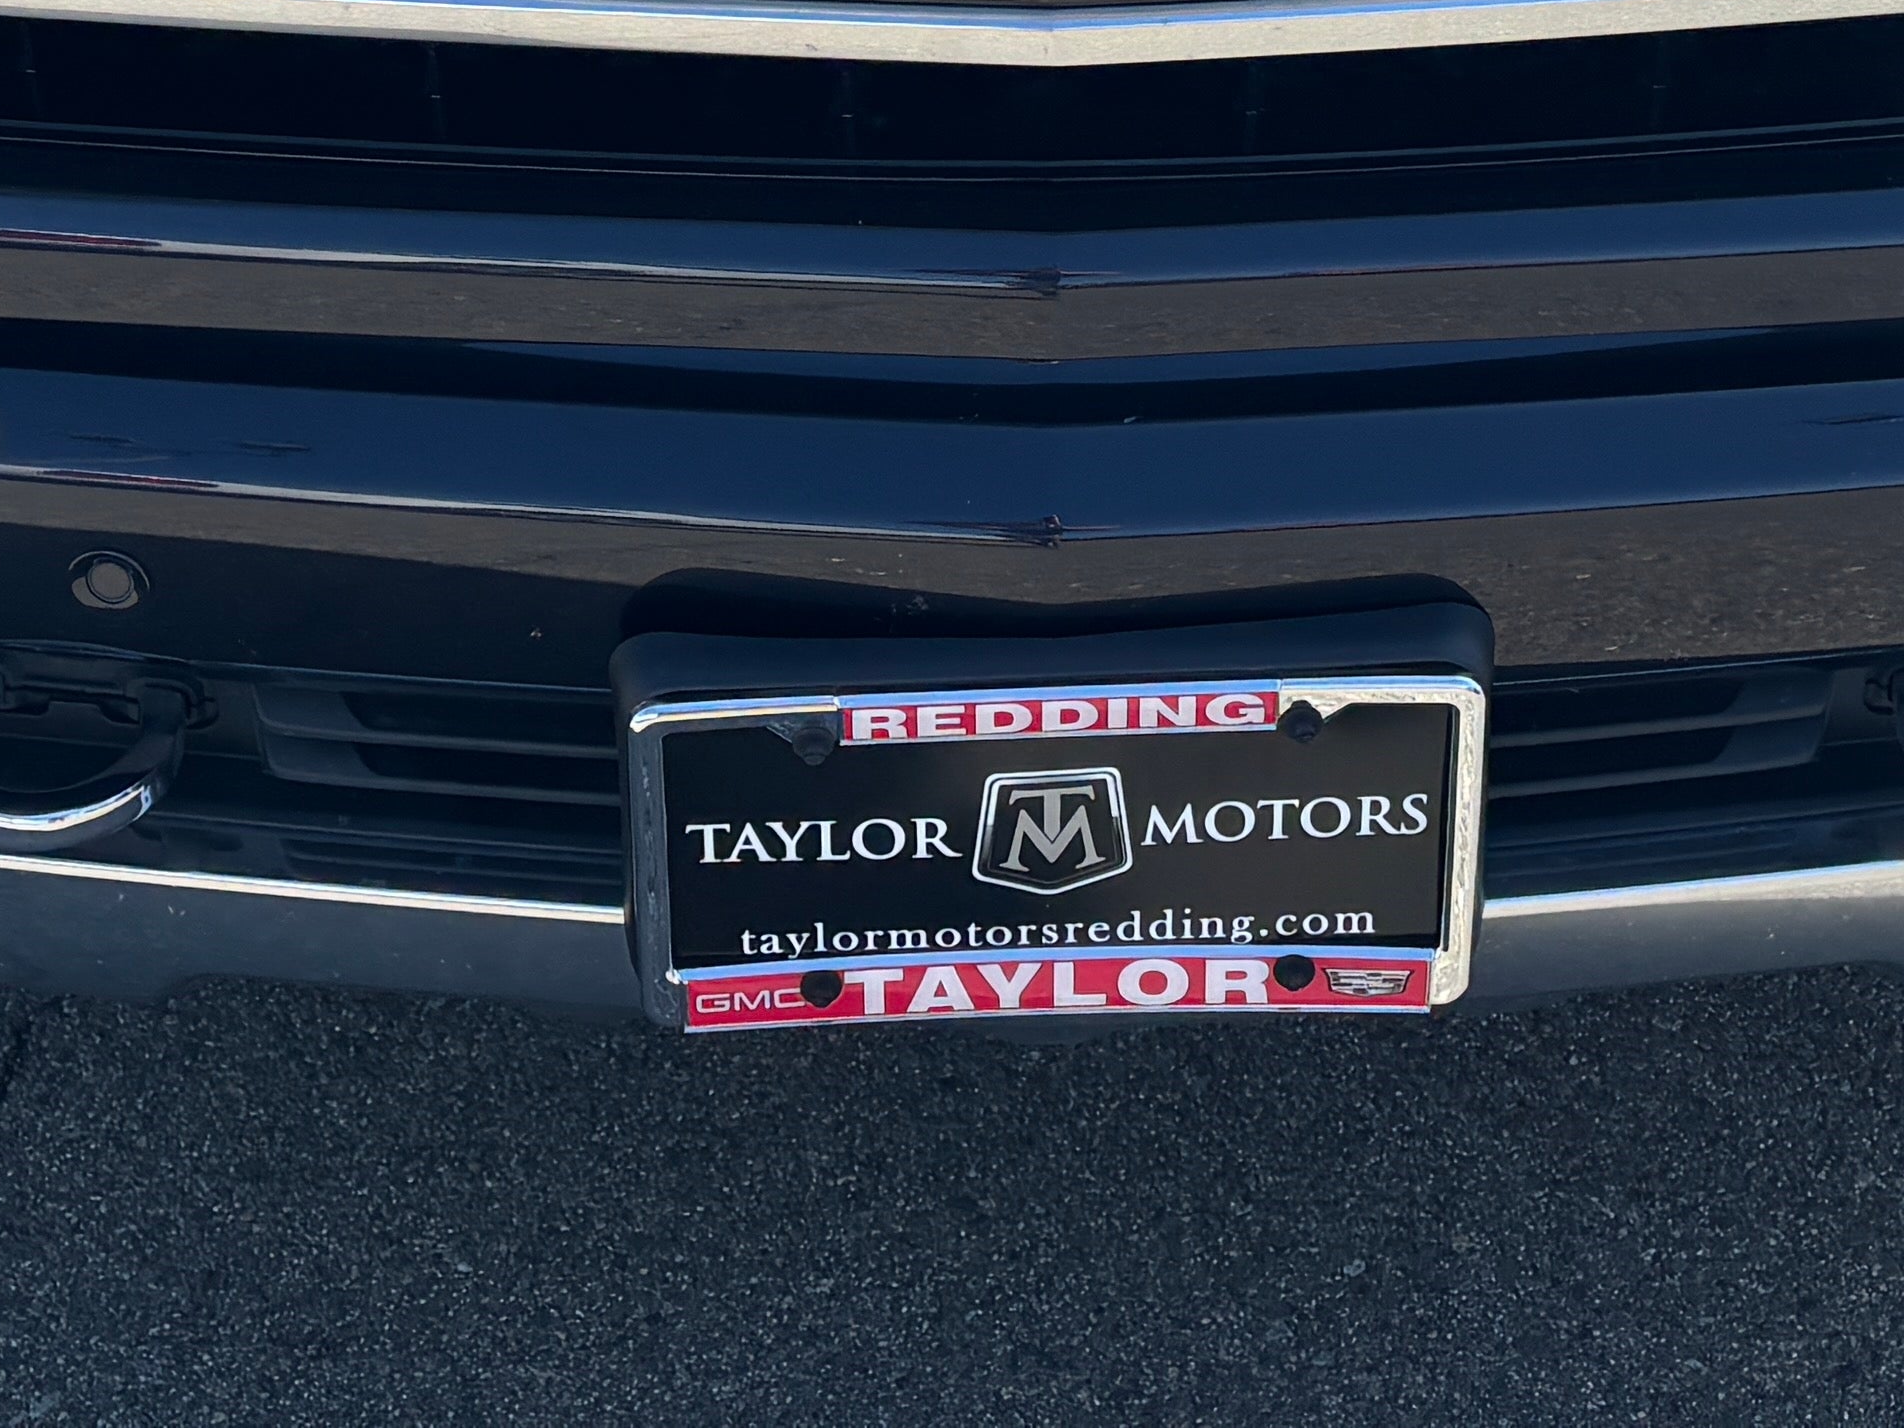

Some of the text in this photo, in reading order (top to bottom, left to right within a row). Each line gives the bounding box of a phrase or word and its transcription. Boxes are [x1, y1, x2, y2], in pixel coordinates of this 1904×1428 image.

[851, 693, 1267, 740] REDDING
[685, 793, 1429, 863] TAYLOR MOTORS
[741, 907, 1376, 959] taylormotorsredding.com
[696, 958, 1270, 1016] GMC TAYLOR
